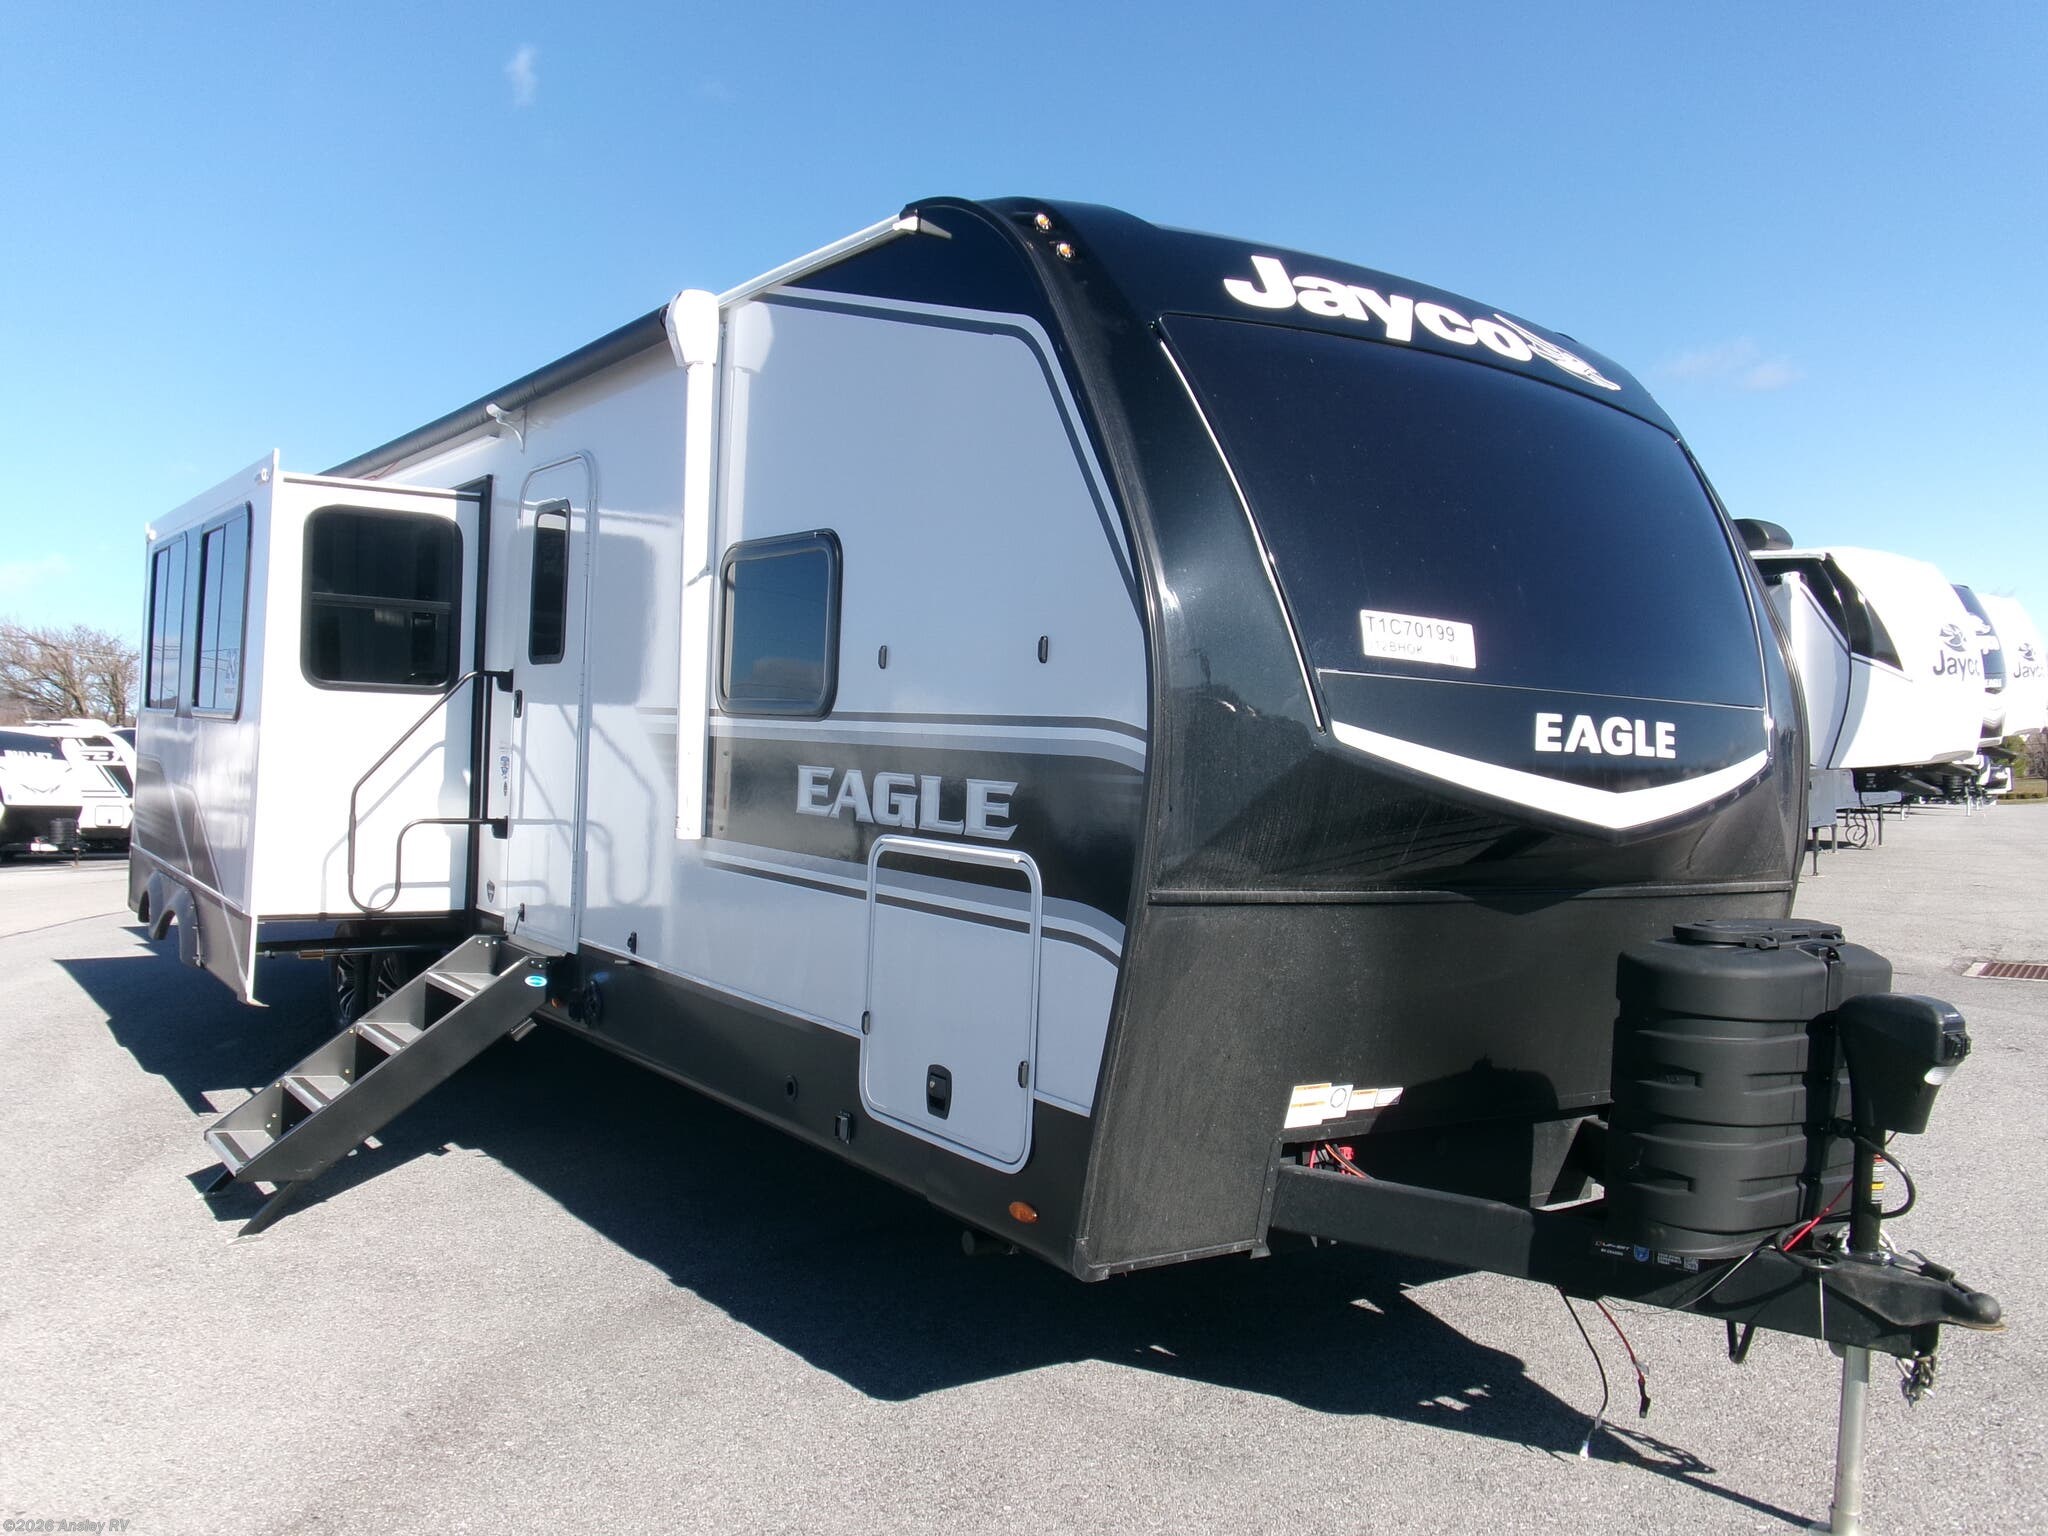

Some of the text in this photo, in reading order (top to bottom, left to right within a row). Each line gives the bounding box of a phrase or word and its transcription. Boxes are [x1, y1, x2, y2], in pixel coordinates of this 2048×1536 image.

[1223, 254, 1532, 362] Jayco
[1365, 615, 1455, 642] T1C70199
[1534, 712, 1676, 760] EAGLE
[796, 764, 1018, 841] EAGLE
